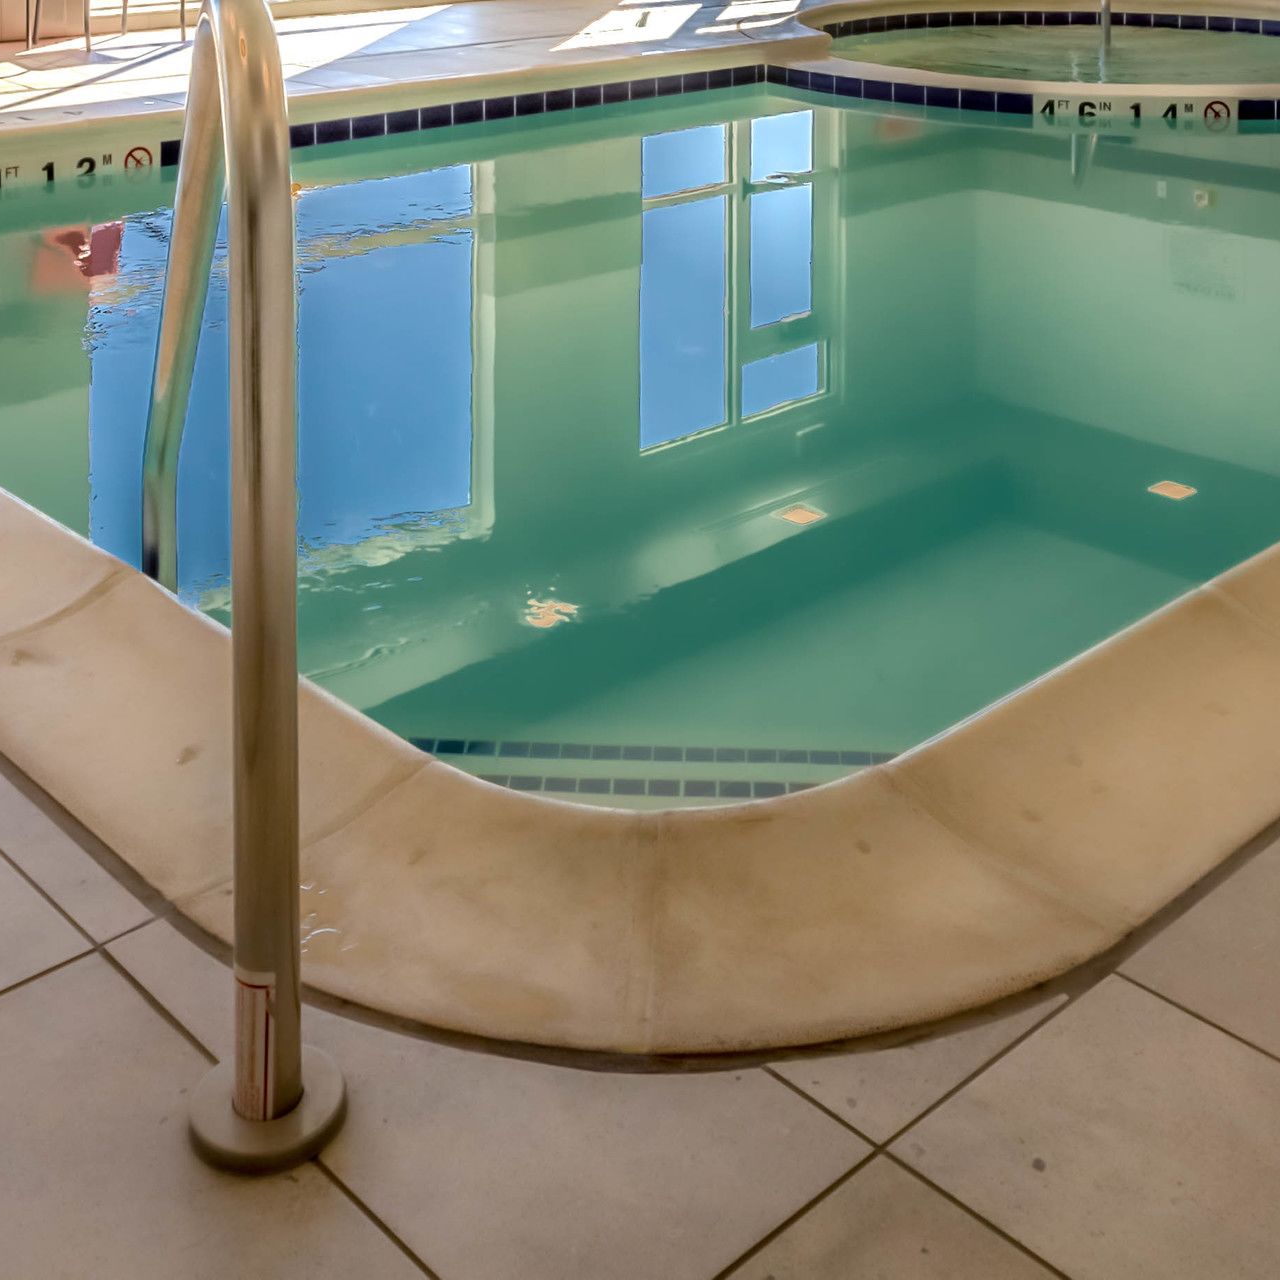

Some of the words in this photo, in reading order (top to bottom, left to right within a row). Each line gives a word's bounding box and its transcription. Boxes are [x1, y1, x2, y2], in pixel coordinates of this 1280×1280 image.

[1058, 100, 1070, 110] FT
[1099, 101, 1112, 112] IN
[5, 166, 19, 178] FT
